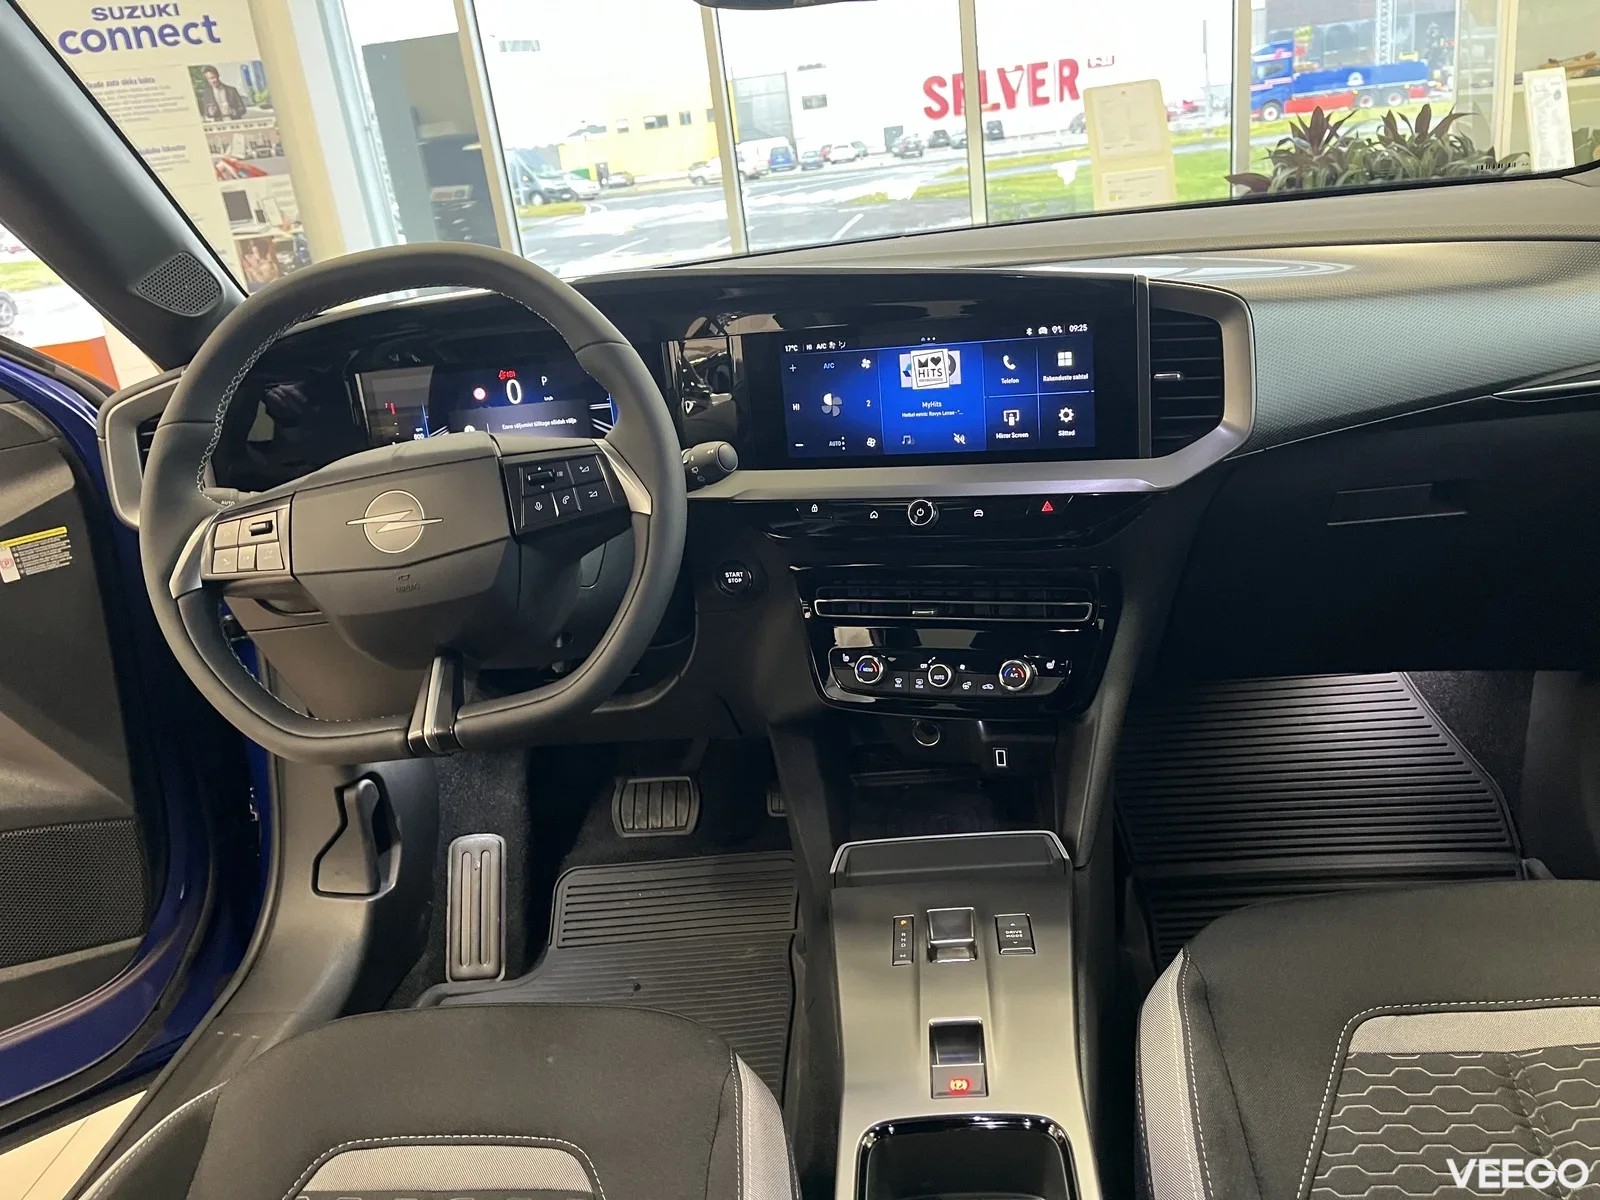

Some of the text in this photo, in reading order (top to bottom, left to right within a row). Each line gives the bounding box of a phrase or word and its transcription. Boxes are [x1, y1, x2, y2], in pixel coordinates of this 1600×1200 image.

[91, 3, 180, 21] SUZUKI
[58, 14, 221, 55] connect
[1069, 324, 1088, 332] 09:25
[785, 344, 798, 352] 17°C
[541, 376, 548, 386] P
[1043, 374, 1072, 382] Rakenduste
[506, 379, 522, 404] 0
[793, 403, 800, 411] HI
[922, 401, 942, 409] MyHits
